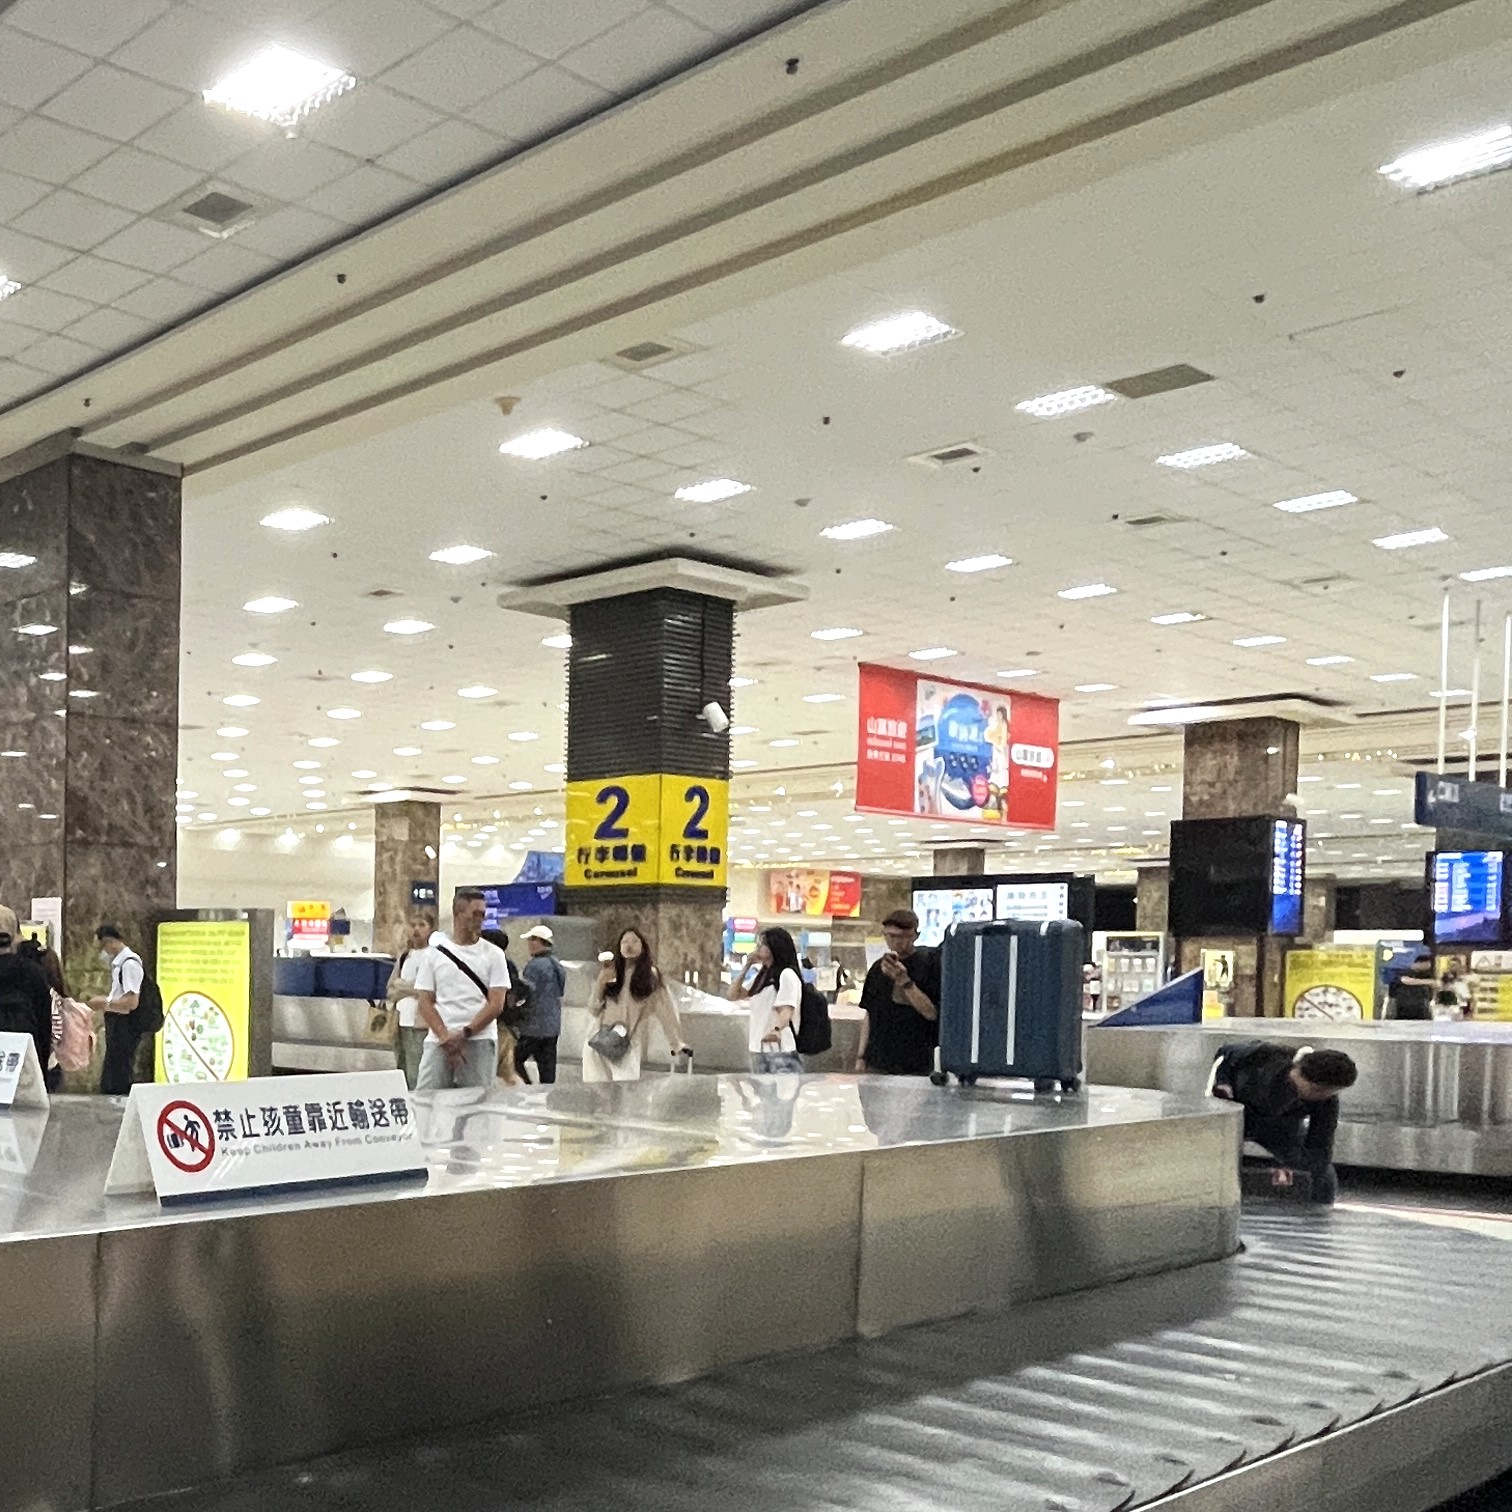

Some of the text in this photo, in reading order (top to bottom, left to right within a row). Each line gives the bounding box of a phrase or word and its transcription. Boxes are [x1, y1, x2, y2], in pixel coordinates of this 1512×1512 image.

[594, 785, 630, 840] 2
[683, 784, 710, 840] 2
[213, 1097, 409, 1142] 禁止孩童靠近輸送帶
[221, 1146, 251, 1158] Keep
[253, 1142, 301, 1155] Children
[304, 1138, 332, 1151] Away
[335, 1136, 362, 1147] From
